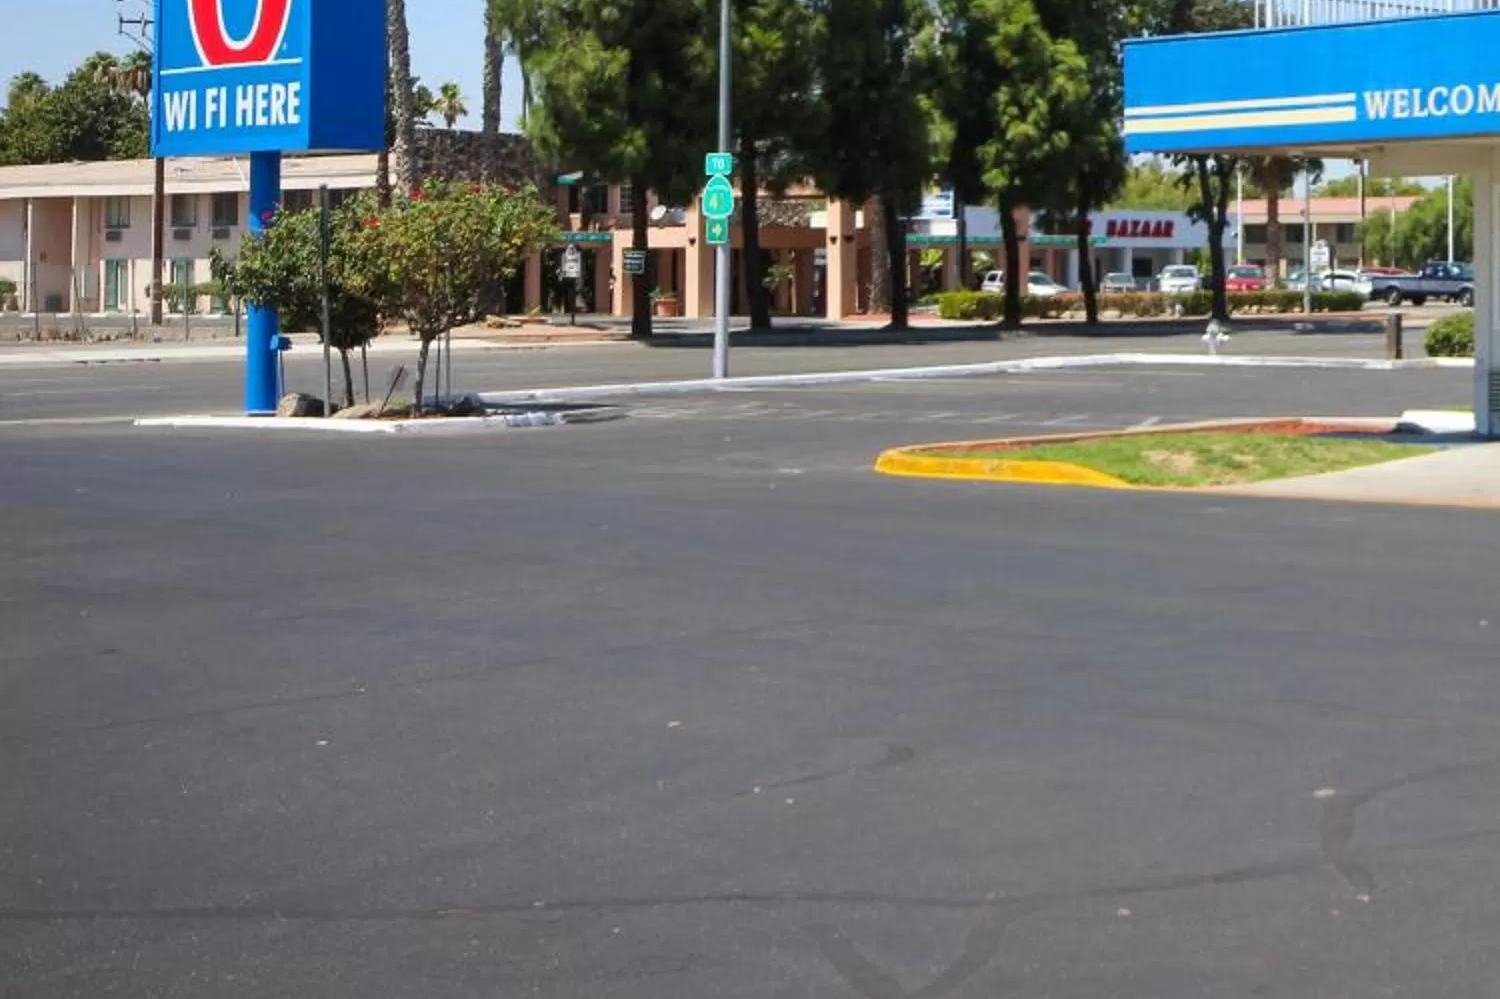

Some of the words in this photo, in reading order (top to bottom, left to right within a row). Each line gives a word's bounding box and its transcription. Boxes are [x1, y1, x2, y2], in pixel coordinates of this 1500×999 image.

[163, 89, 197, 133] WI
[205, 86, 227, 129] FI
[235, 81, 301, 127] HERE
[710, 157, 726, 170] TO
[1107, 219, 1174, 238] BAZAAR
